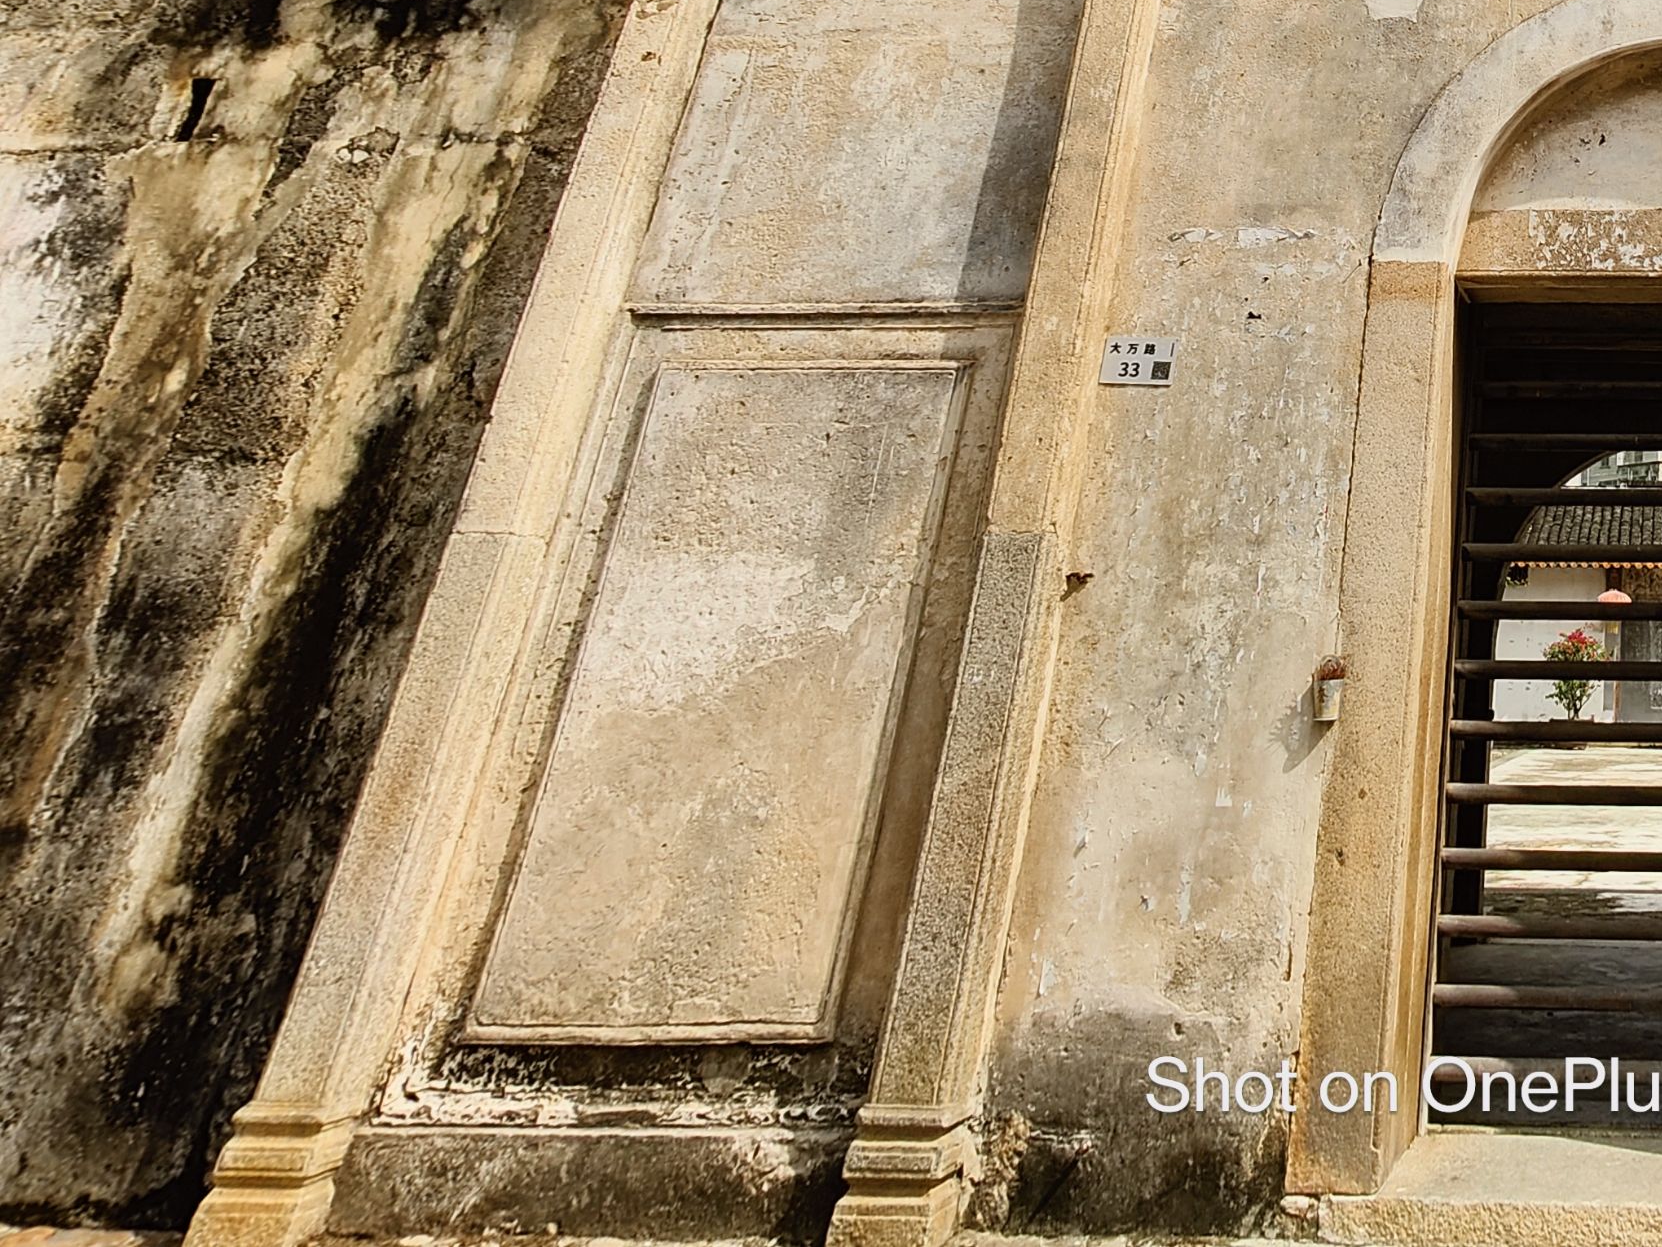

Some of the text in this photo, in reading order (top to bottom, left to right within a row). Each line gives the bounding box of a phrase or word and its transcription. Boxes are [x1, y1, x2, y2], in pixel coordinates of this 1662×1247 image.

[1110, 342, 1156, 355] 大万路
[1118, 362, 1140, 377] 33
